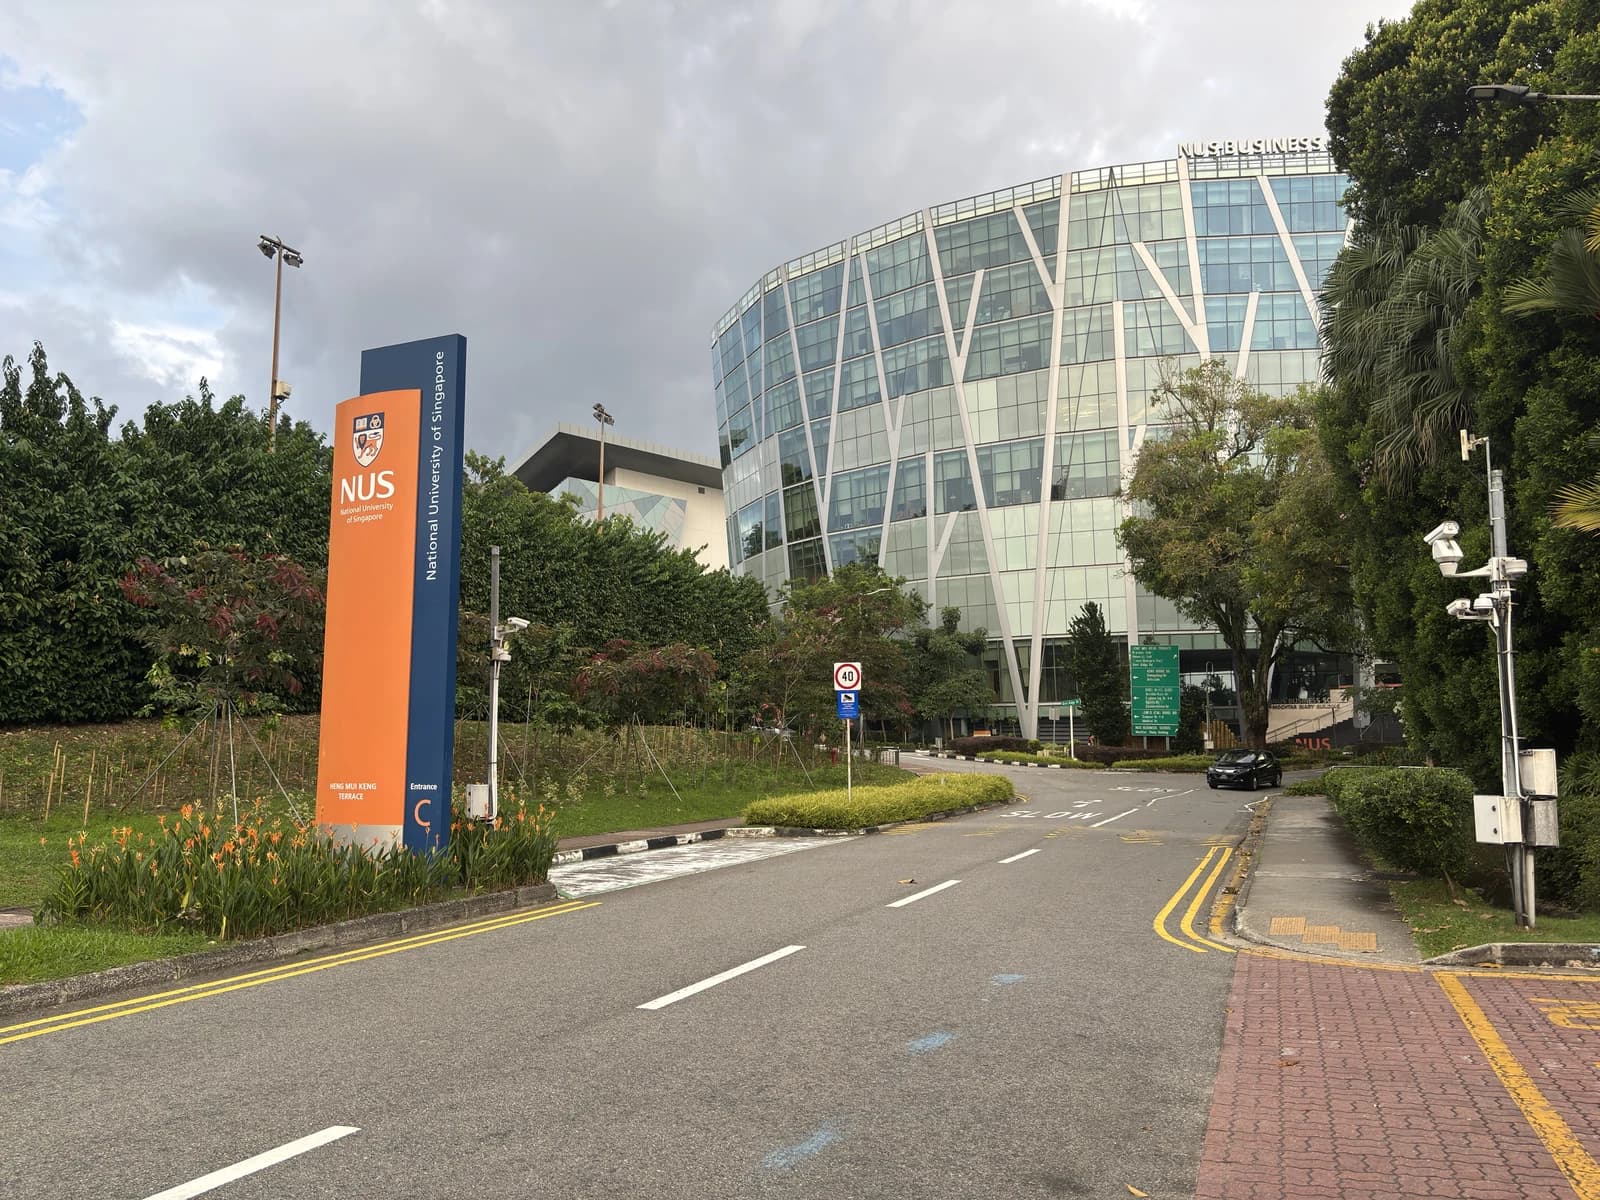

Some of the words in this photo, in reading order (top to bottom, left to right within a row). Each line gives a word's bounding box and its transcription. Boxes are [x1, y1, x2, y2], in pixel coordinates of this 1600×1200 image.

[1178, 141, 1218, 157] NUS
[1223, 137, 1322, 155] BUSINESS
[431, 351, 445, 422] Singapore
[433, 426, 442, 440] of
[340, 470, 395, 504] NUS
[427, 446, 443, 515] University
[340, 506, 361, 515] National
[362, 502, 394, 512] University
[353, 513, 383, 523] Singapore
[426, 515, 439, 580] National
[842, 671, 854, 682] 40
[410, 782, 438, 791] Entrance
[414, 799, 431, 827] C
[1000, 810, 1104, 820] SLOW
